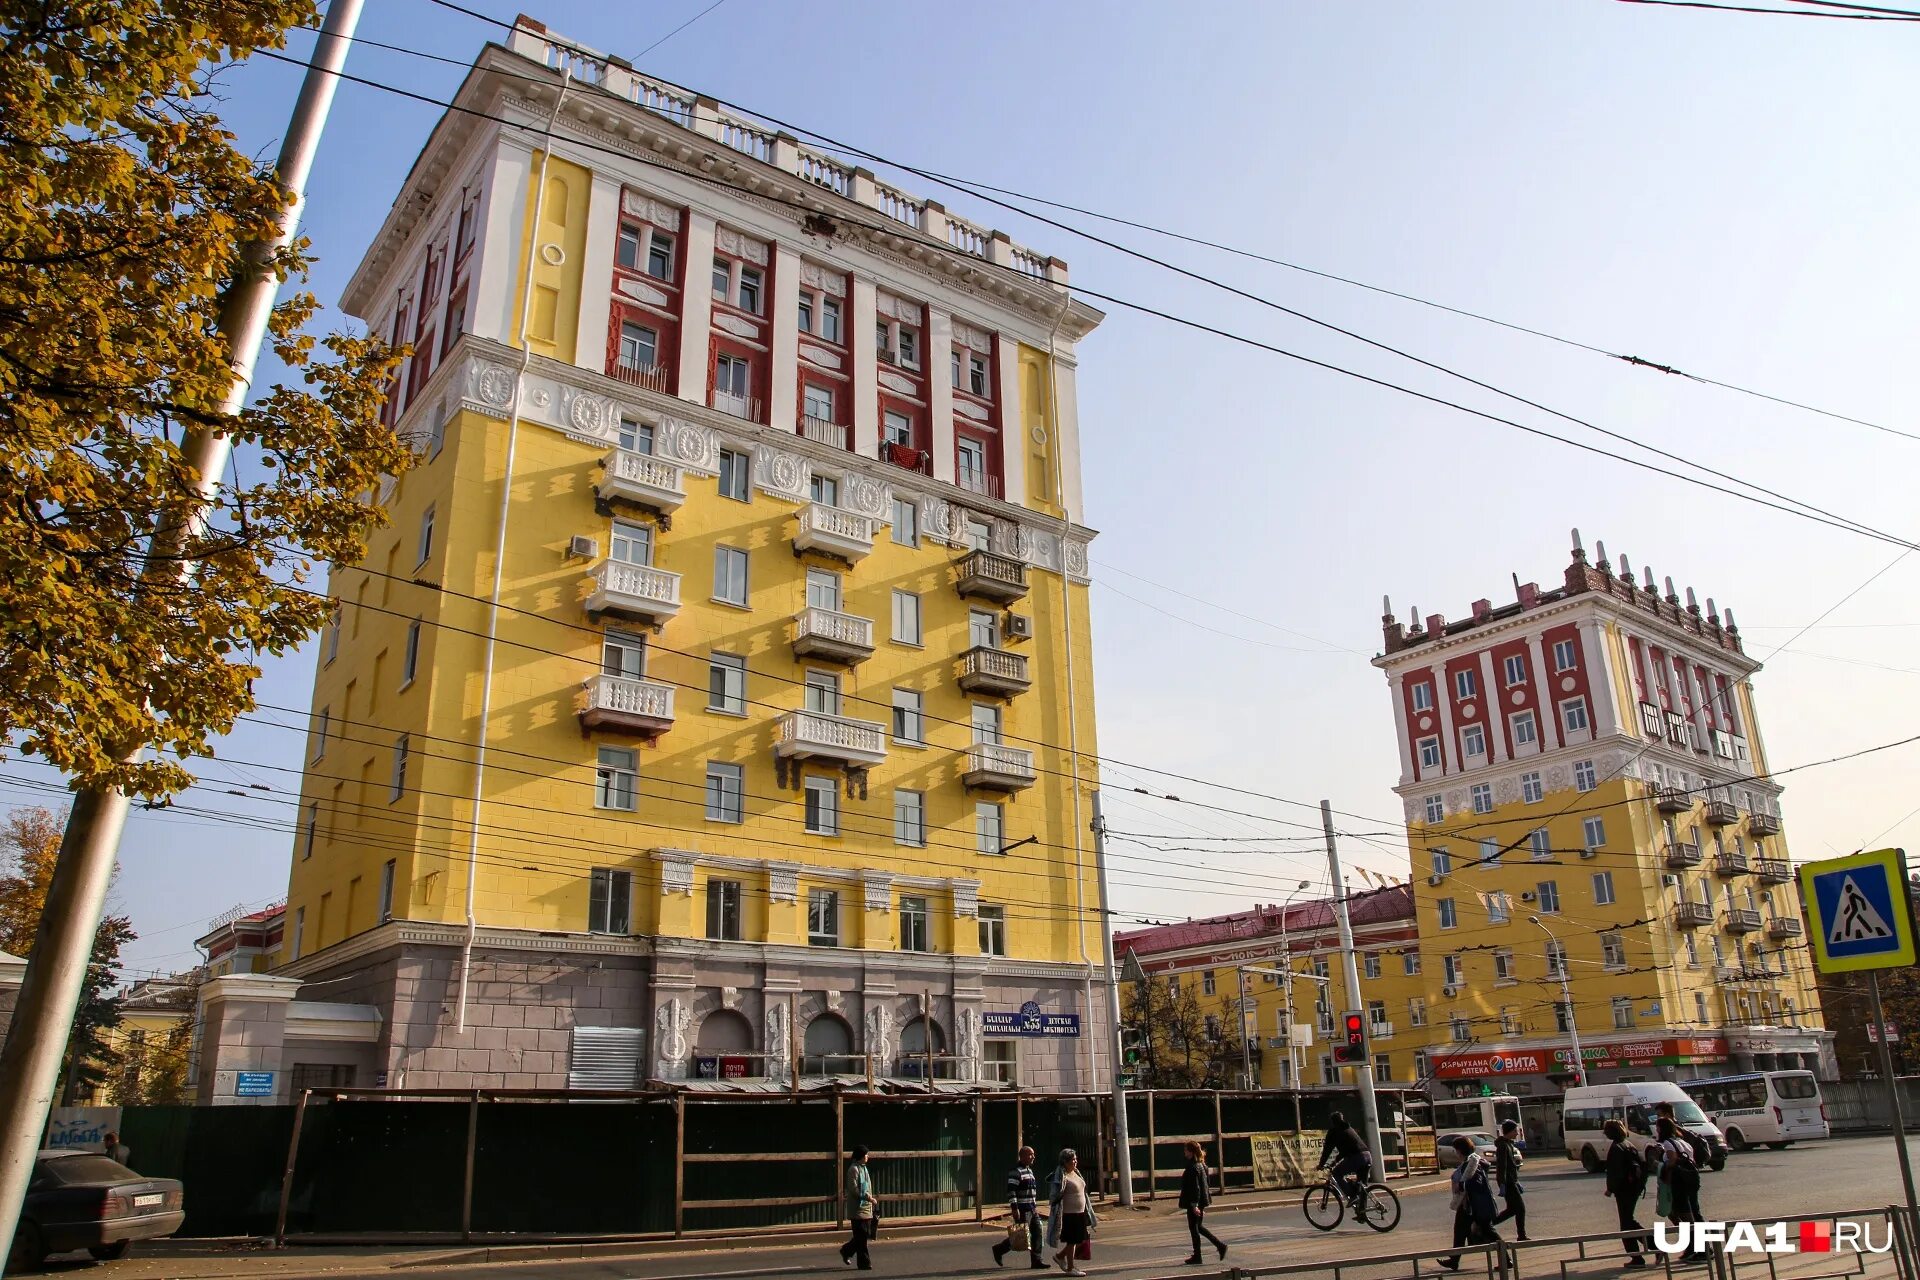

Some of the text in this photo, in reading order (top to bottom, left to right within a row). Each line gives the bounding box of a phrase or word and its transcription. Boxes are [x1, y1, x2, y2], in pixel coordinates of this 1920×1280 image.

[1047, 1017, 1072, 1025] ДЕТСКАЯ
[1042, 1026, 1078, 1034] БИБЛИОТЕКА
[1350, 1033, 1362, 1044] 27
[1555, 1047, 1609, 1062] ОИКА
[1624, 1047, 1664, 1057] ВЗГЛЯД
[1505, 1056, 1538, 1069] ВИТА
[1461, 1067, 1489, 1075] АПТЕКА
[1254, 1140, 1300, 1150] ЮВЕЛИРНАЯ
